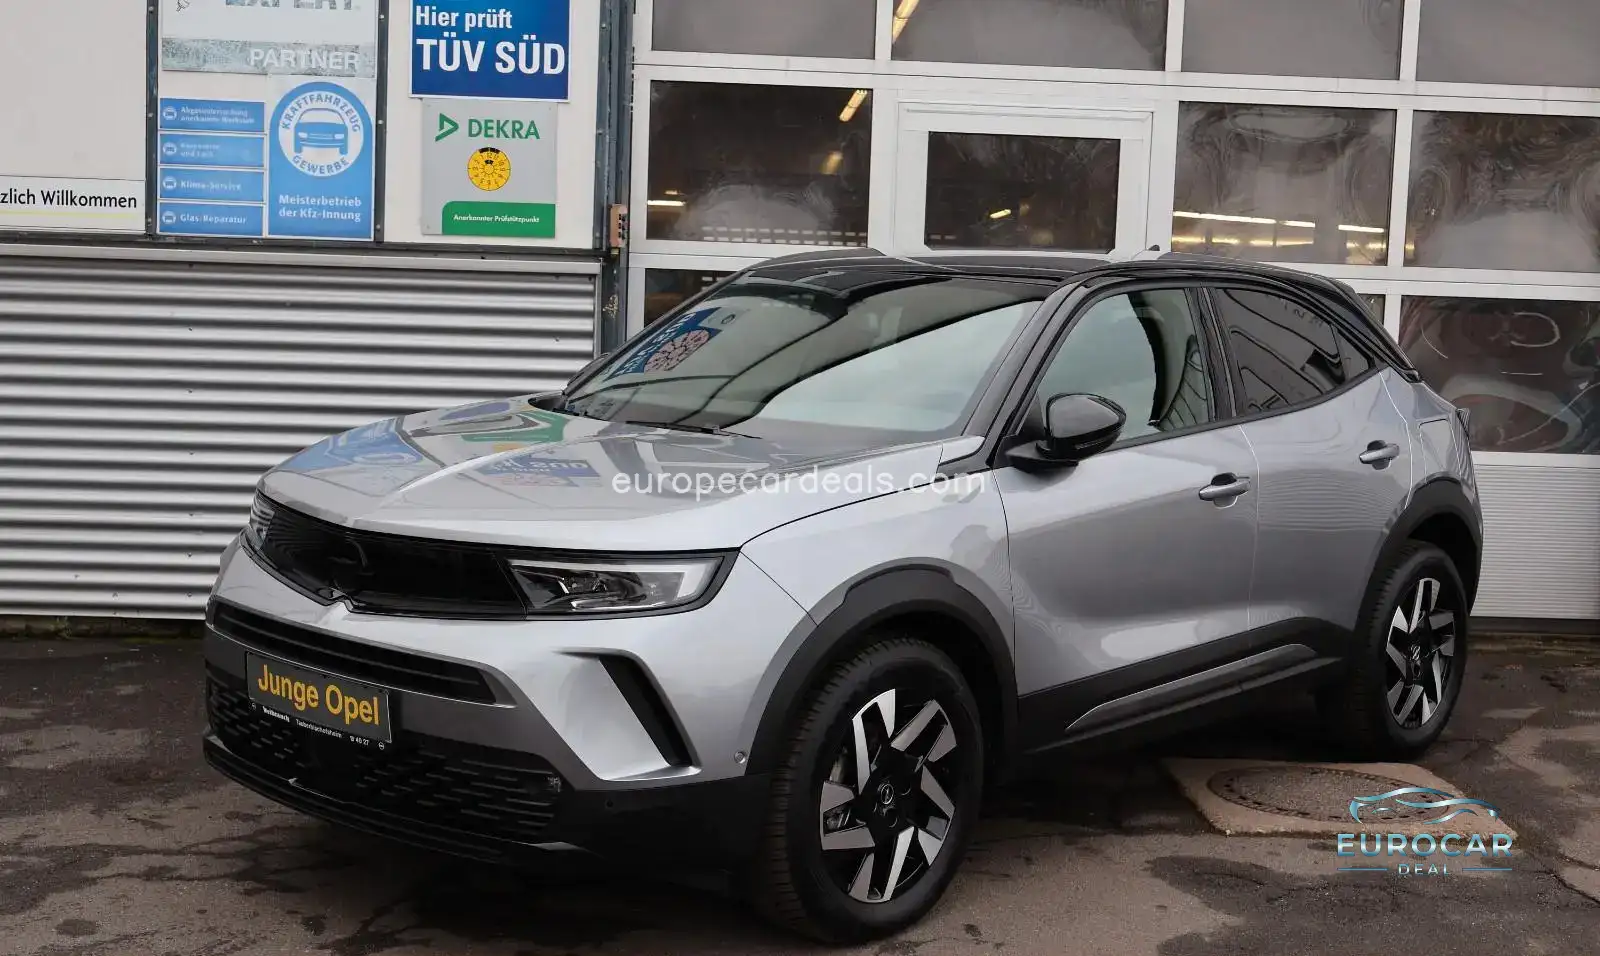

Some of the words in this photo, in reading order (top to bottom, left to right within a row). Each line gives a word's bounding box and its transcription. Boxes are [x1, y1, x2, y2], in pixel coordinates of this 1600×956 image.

[415, 5, 459, 27] Hier
[464, 9, 513, 32] prüft
[250, 49, 360, 70] PARTNER
[416, 31, 485, 72] TÜV
[495, 34, 565, 75] SÜD
[281, 93, 361, 133] KRAFTFAHRZEUG
[468, 118, 541, 140] DEKRA
[292, 154, 350, 175] GEWERBE
[0, 188, 36, 205] zlich
[40, 190, 137, 208] Willkommen
[279, 194, 362, 208] Meisterbetrieb
[278, 207, 297, 218] der
[299, 208, 361, 222] Kfz-Innung
[453, 213, 493, 222] Anerkannter
[494, 214, 540, 224] Prüfstützpunkt
[258, 664, 319, 711] Junge
[325, 684, 380, 726] Opel
